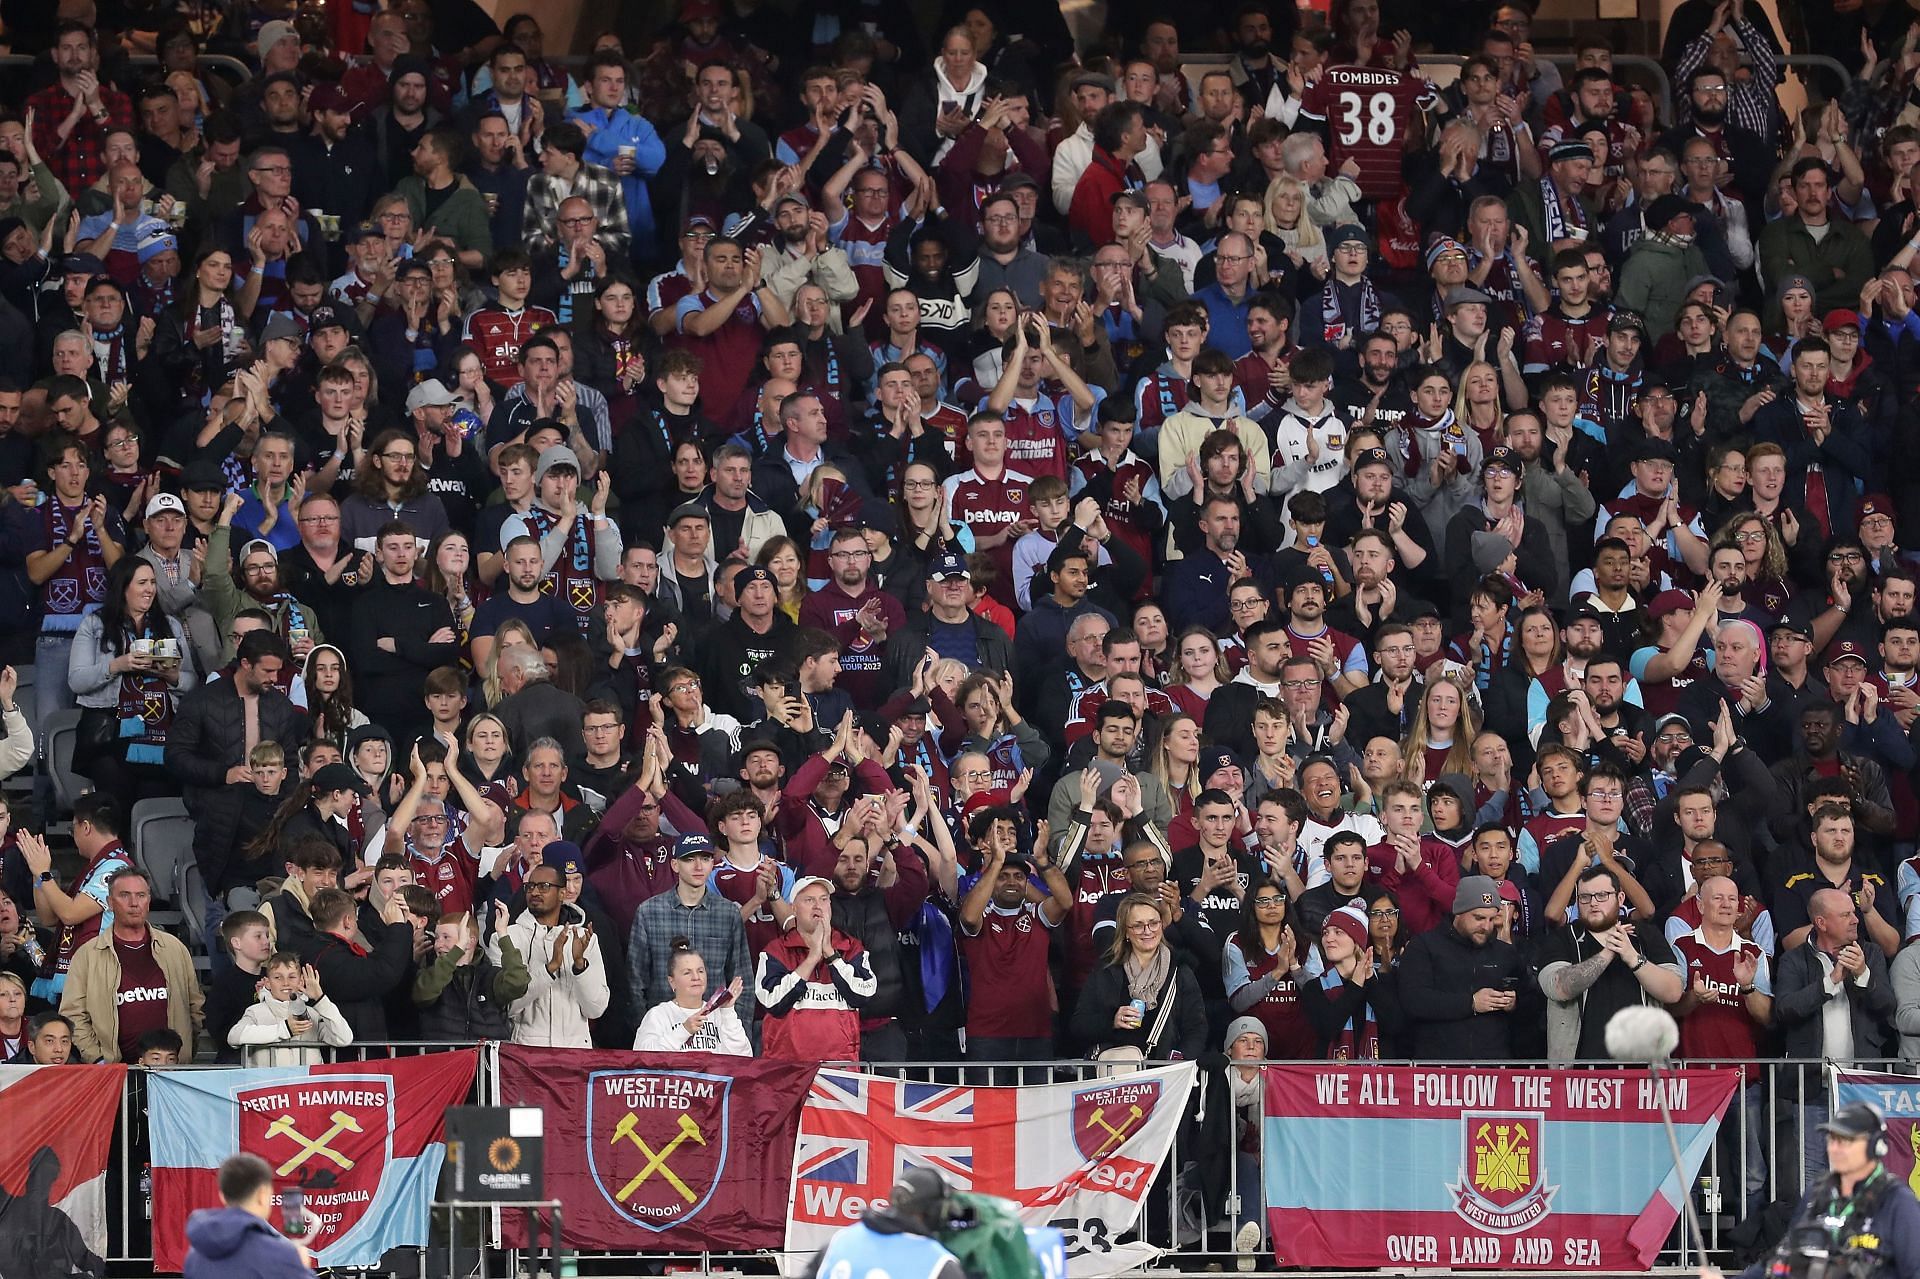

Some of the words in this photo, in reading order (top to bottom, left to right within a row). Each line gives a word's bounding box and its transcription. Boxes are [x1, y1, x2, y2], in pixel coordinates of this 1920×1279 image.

[1330, 71, 1399, 86] TOMBIDES
[1339, 91, 1396, 146] 38
[1347, 405, 1406, 422] THASHER
[1010, 448, 1054, 459] MOTORS
[428, 482, 467, 497] etway
[964, 509, 1020, 524] betway
[841, 662, 862, 671] TOUR
[863, 662, 882, 671] 2023
[1200, 895, 1240, 909] etwa
[1705, 974, 1740, 996] lpari
[116, 987, 168, 1006] betwa
[1717, 996, 1739, 1007] ADING
[604, 1078, 659, 1096] WEST
[665, 1079, 714, 1099] HAM
[1082, 1089, 1118, 1102] WEST
[1121, 1085, 1153, 1096] HAM
[1315, 1074, 1349, 1105] WE
[1359, 1074, 1399, 1105] ALL
[1413, 1074, 1499, 1107] FOLLOW
[1512, 1075, 1552, 1108] THE
[1565, 1076, 1625, 1109] WEST
[1638, 1077, 1688, 1111] HAM
[298, 1091, 385, 1107] HAMMERS
[626, 1094, 691, 1110] UNITED
[1097, 1094, 1138, 1106] UNITED
[315, 1190, 370, 1206] AUSTRALIA
[803, 1184, 890, 1220] Wes
[631, 1202, 682, 1217] LONDON
[1464, 1201, 1487, 1220] WEST
[1488, 1213, 1510, 1228] HAM
[1510, 1203, 1542, 1228] UNITED
[1386, 1235, 1438, 1263] OVER
[1449, 1236, 1501, 1264] LAND
[1512, 1238, 1554, 1265] AND
[1564, 1238, 1601, 1266] SEA
